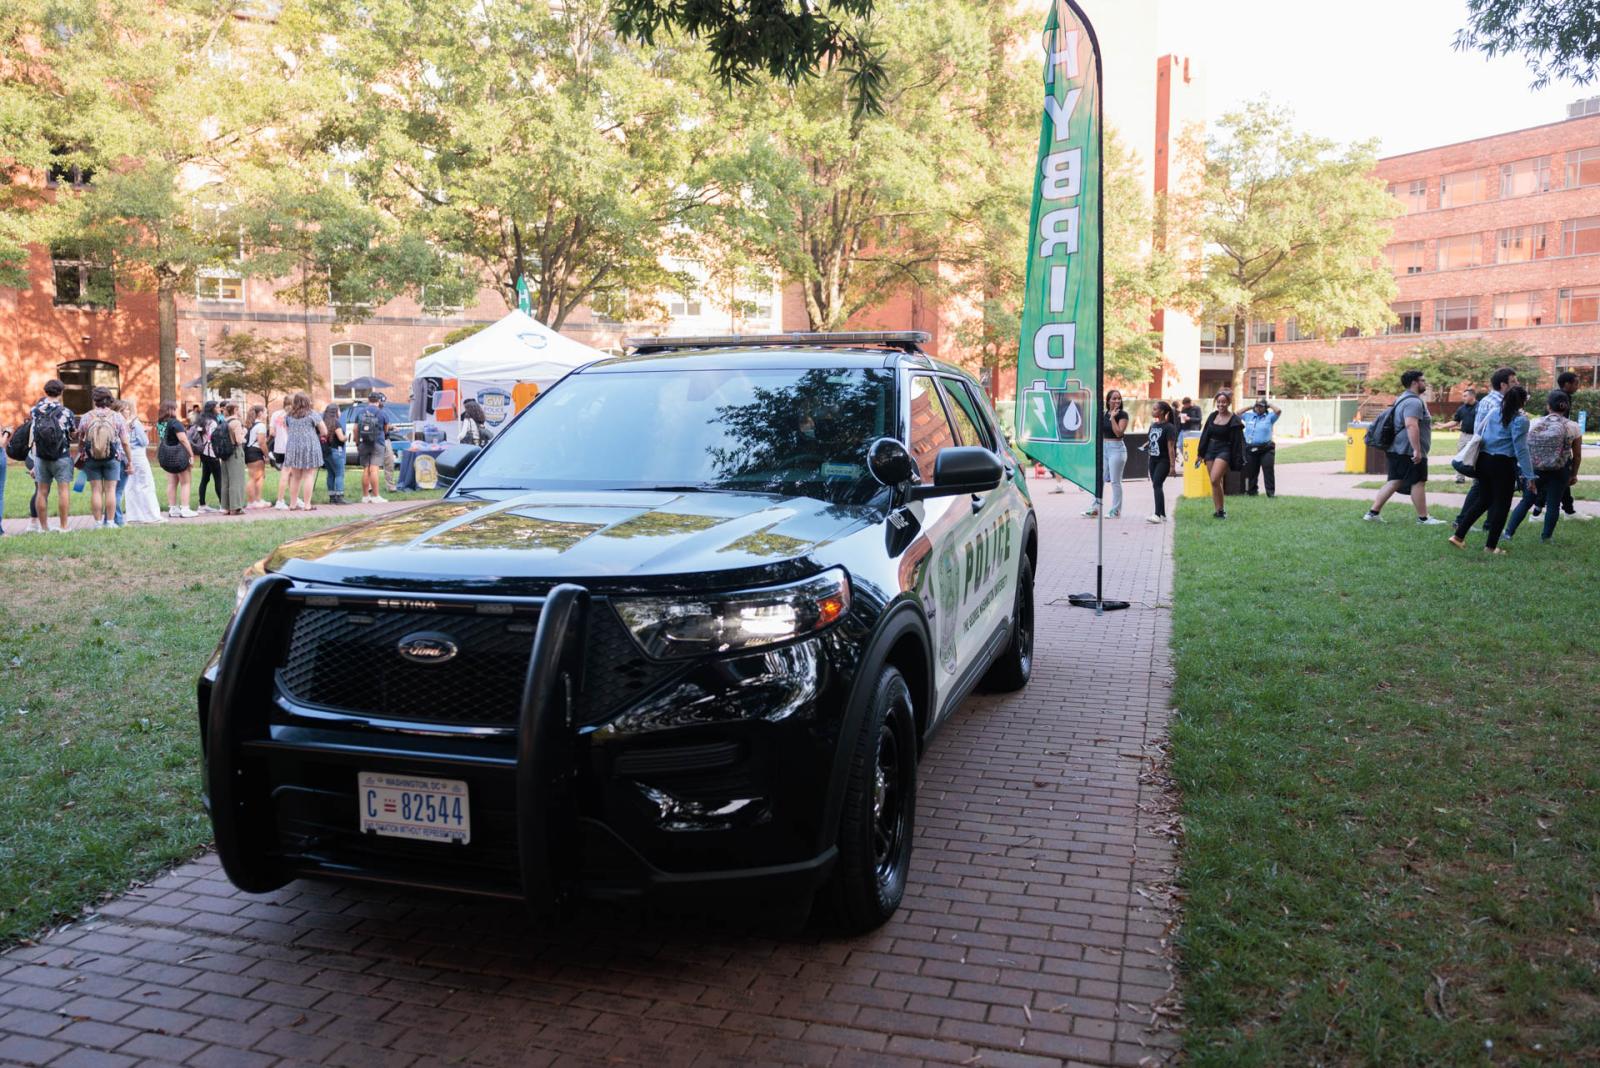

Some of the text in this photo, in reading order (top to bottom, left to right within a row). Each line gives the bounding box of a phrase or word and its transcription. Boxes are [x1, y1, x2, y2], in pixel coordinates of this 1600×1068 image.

[485, 396, 504, 406] GW
[963, 509, 1010, 605] POLICE
[408, 640, 444, 657] Ford
[367, 789, 464, 826] C 82544
